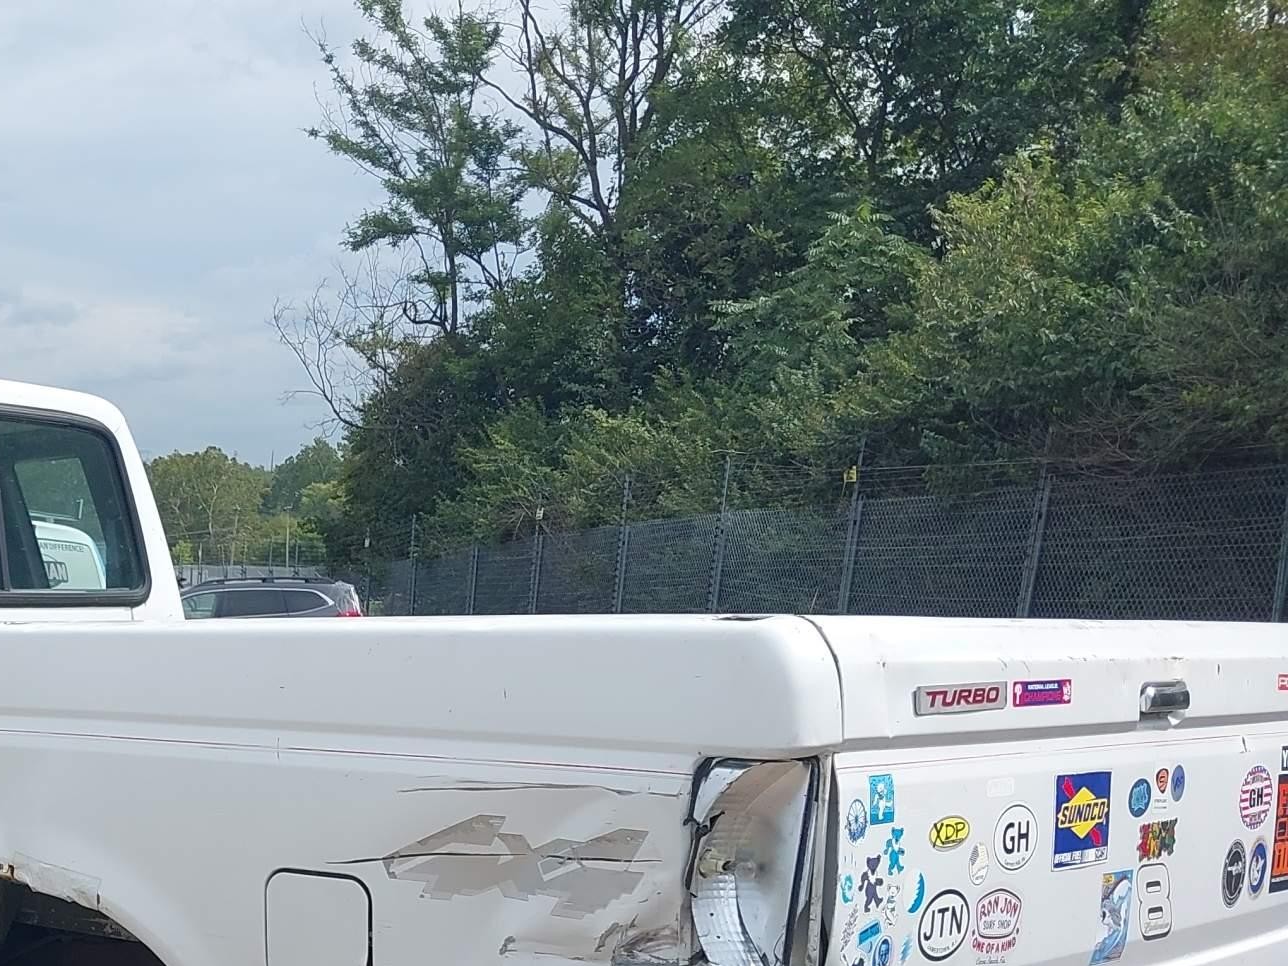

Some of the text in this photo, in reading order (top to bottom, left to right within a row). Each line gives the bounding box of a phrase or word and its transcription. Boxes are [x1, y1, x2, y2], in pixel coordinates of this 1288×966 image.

[925, 686, 1000, 708] TURBO
[1248, 787, 1264, 809] GH
[1059, 800, 1106, 826] SUNOCO
[932, 821, 966, 848] XDP
[1002, 819, 1030, 855] GH
[979, 895, 1018, 921] RON JON
[923, 903, 964, 942] JTN
[983, 919, 1012, 931] SURF SHOP
[972, 937, 985, 953] ONE
[1001, 936, 1016, 953] KIND
